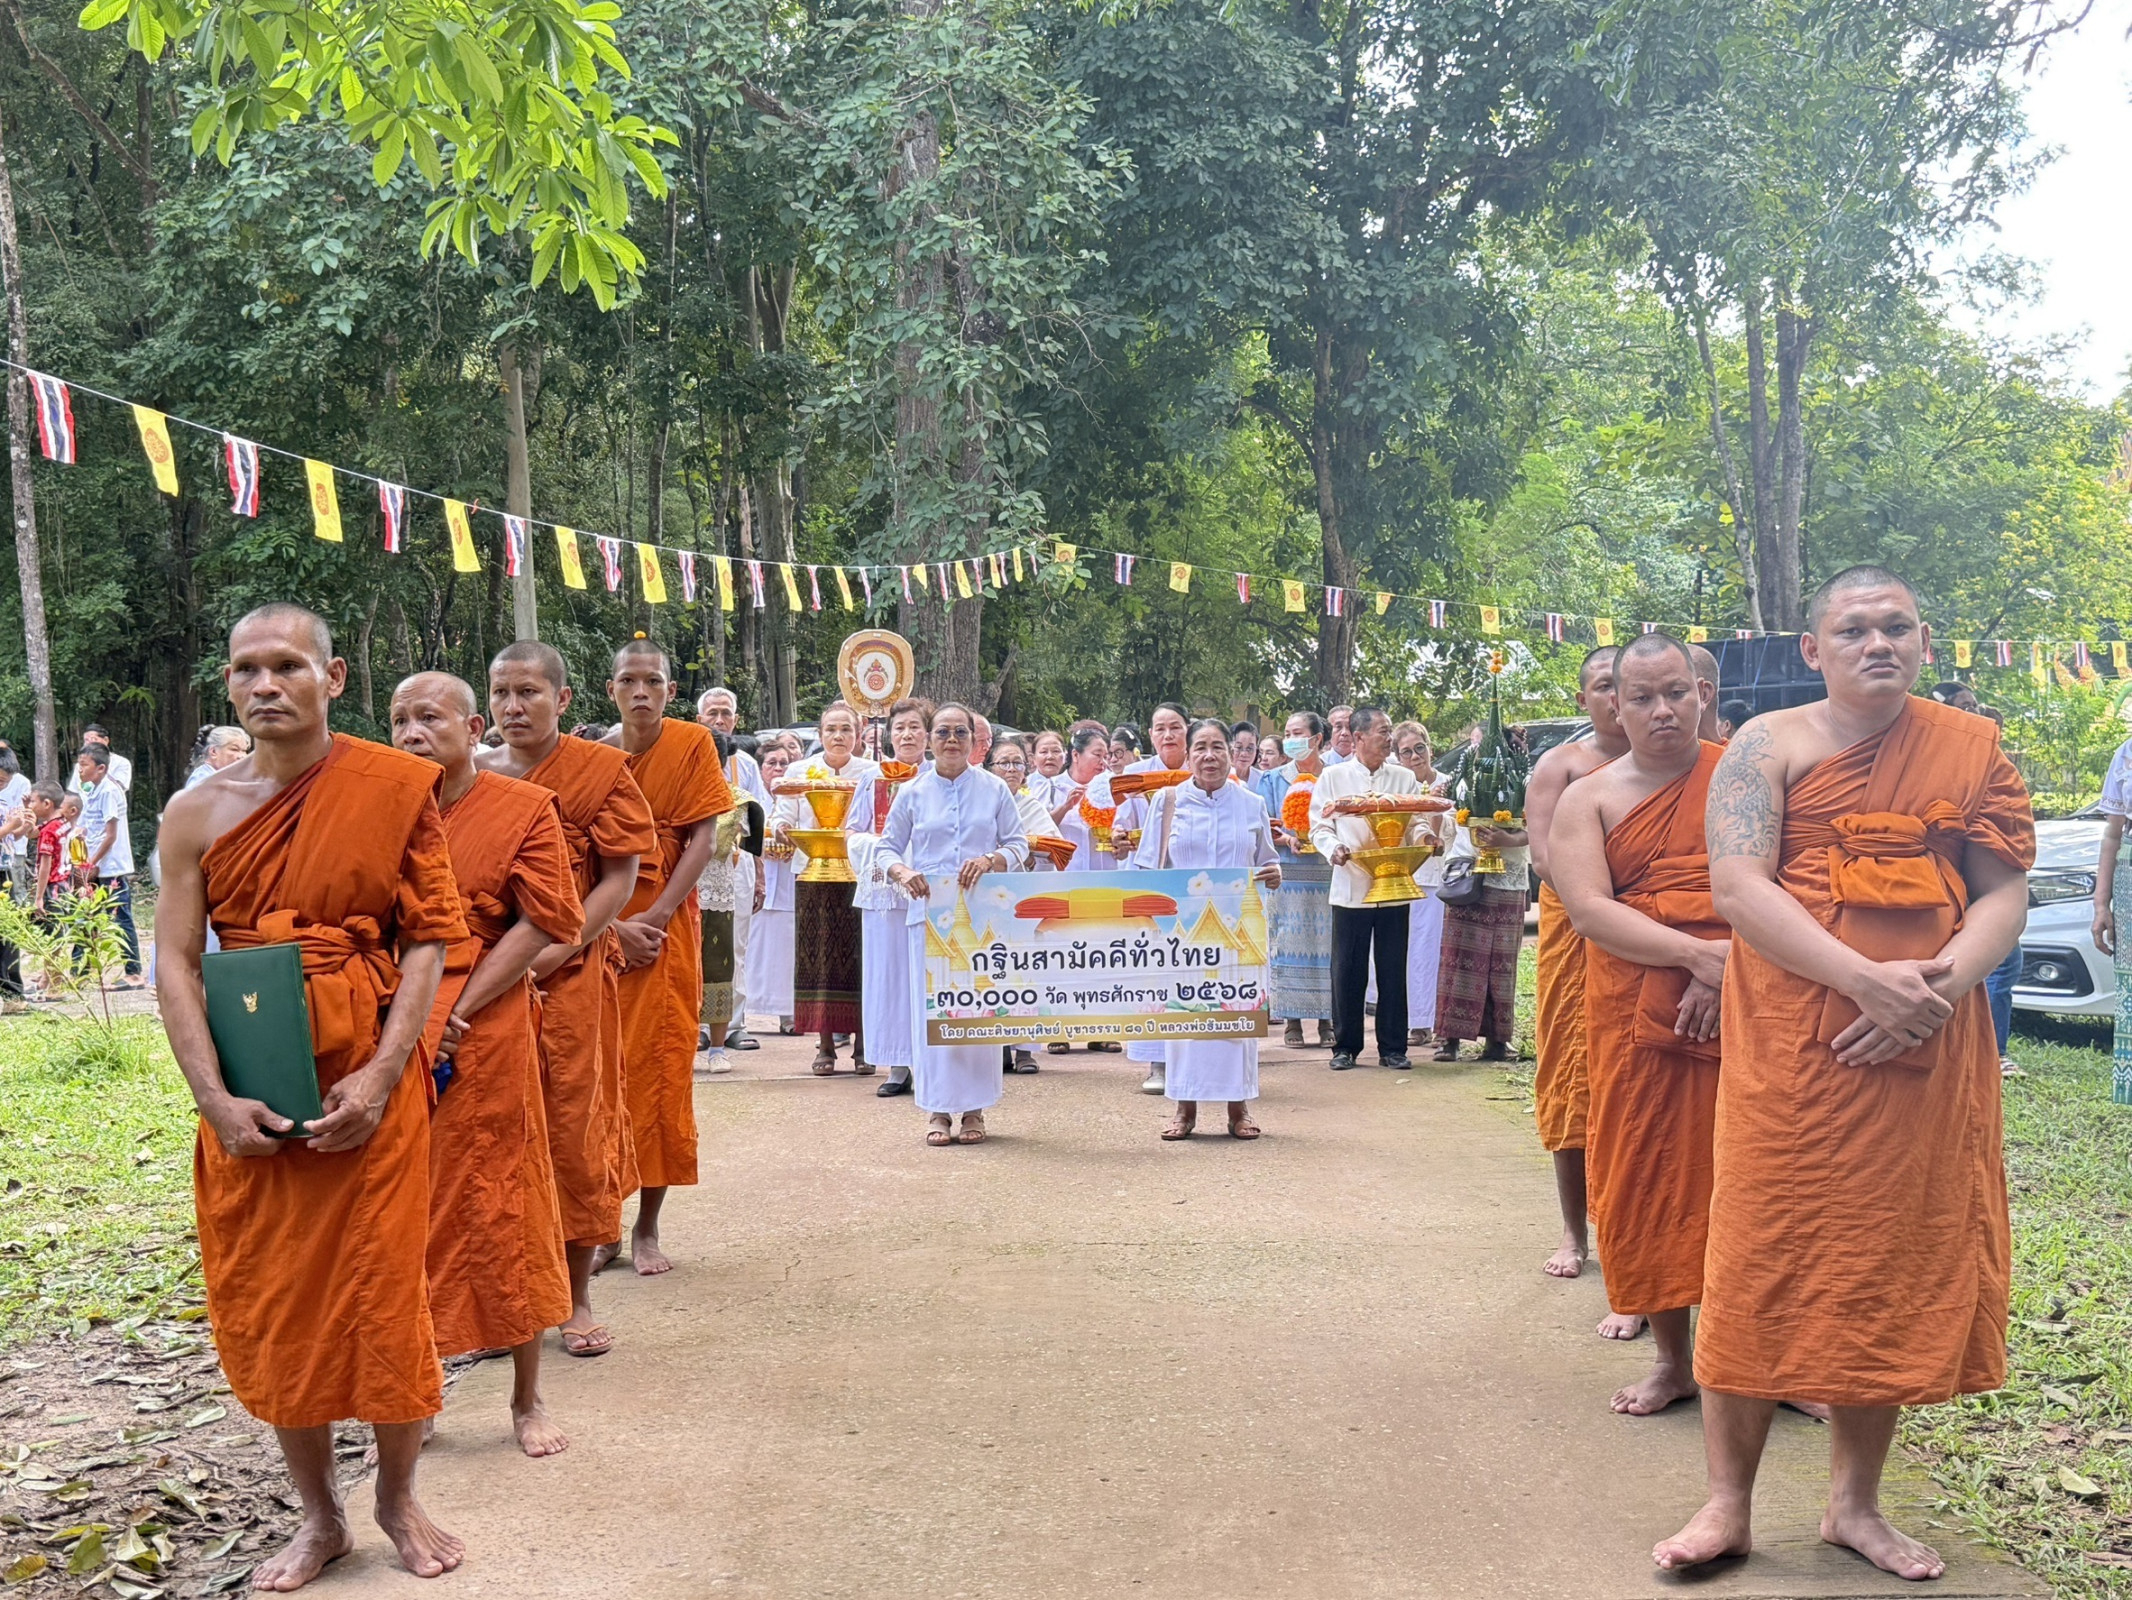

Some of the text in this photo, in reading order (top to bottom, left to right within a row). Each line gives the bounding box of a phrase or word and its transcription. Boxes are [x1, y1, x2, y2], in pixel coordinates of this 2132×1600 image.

[972, 931, 1221, 980] กฐินสามัคคีทั่วไทย
[937, 981, 1258, 1010] ๓๐,๐๐๐ วัด พุทธศักราช ๒๕๖๘
[940, 1025, 963, 1037] โดย
[1065, 1023, 1121, 1039] บูชาธรรม
[1145, 1019, 1156, 1033] ปี
